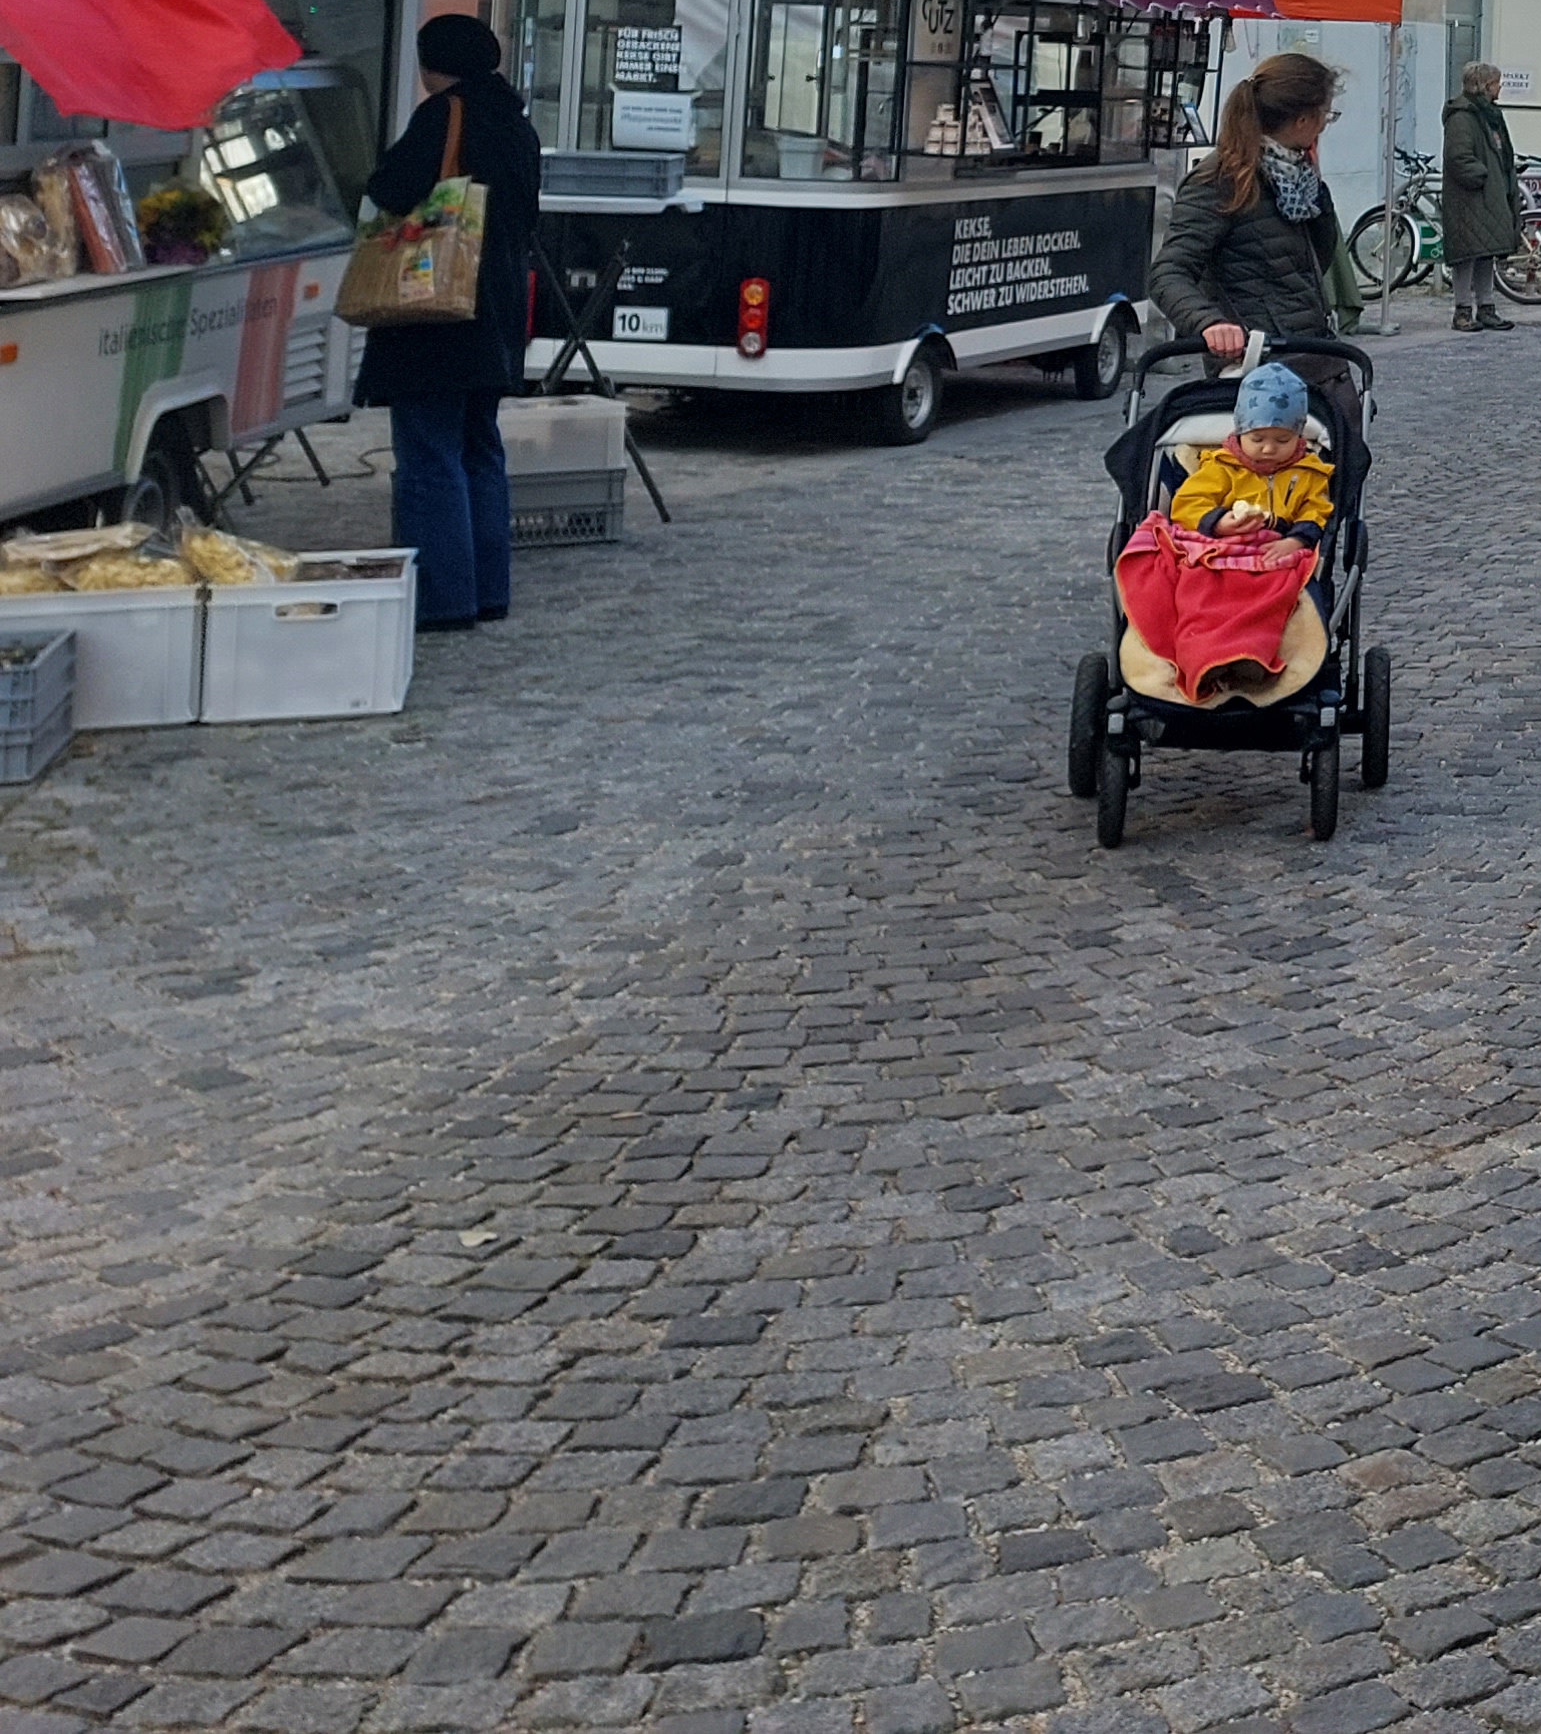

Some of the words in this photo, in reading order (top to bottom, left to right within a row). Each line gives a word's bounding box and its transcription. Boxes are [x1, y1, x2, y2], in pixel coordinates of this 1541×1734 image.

[616, 50, 650, 61] KEKSE
[954, 216, 993, 240] KEKSE,
[952, 242, 971, 265] DIE
[972, 239, 1000, 263] DEIN
[1001, 235, 1035, 259] LEBEN
[1036, 230, 1081, 253] ROCKEN.
[949, 265, 988, 291] LEICHT
[988, 263, 1005, 284] ZU
[1006, 257, 1052, 282] BACKEN.
[946, 287, 997, 316] SCHWER
[997, 285, 1014, 307] ZU
[1015, 274, 1090, 304] WIDERSTEHEN.
[617, 313, 641, 333] 10
